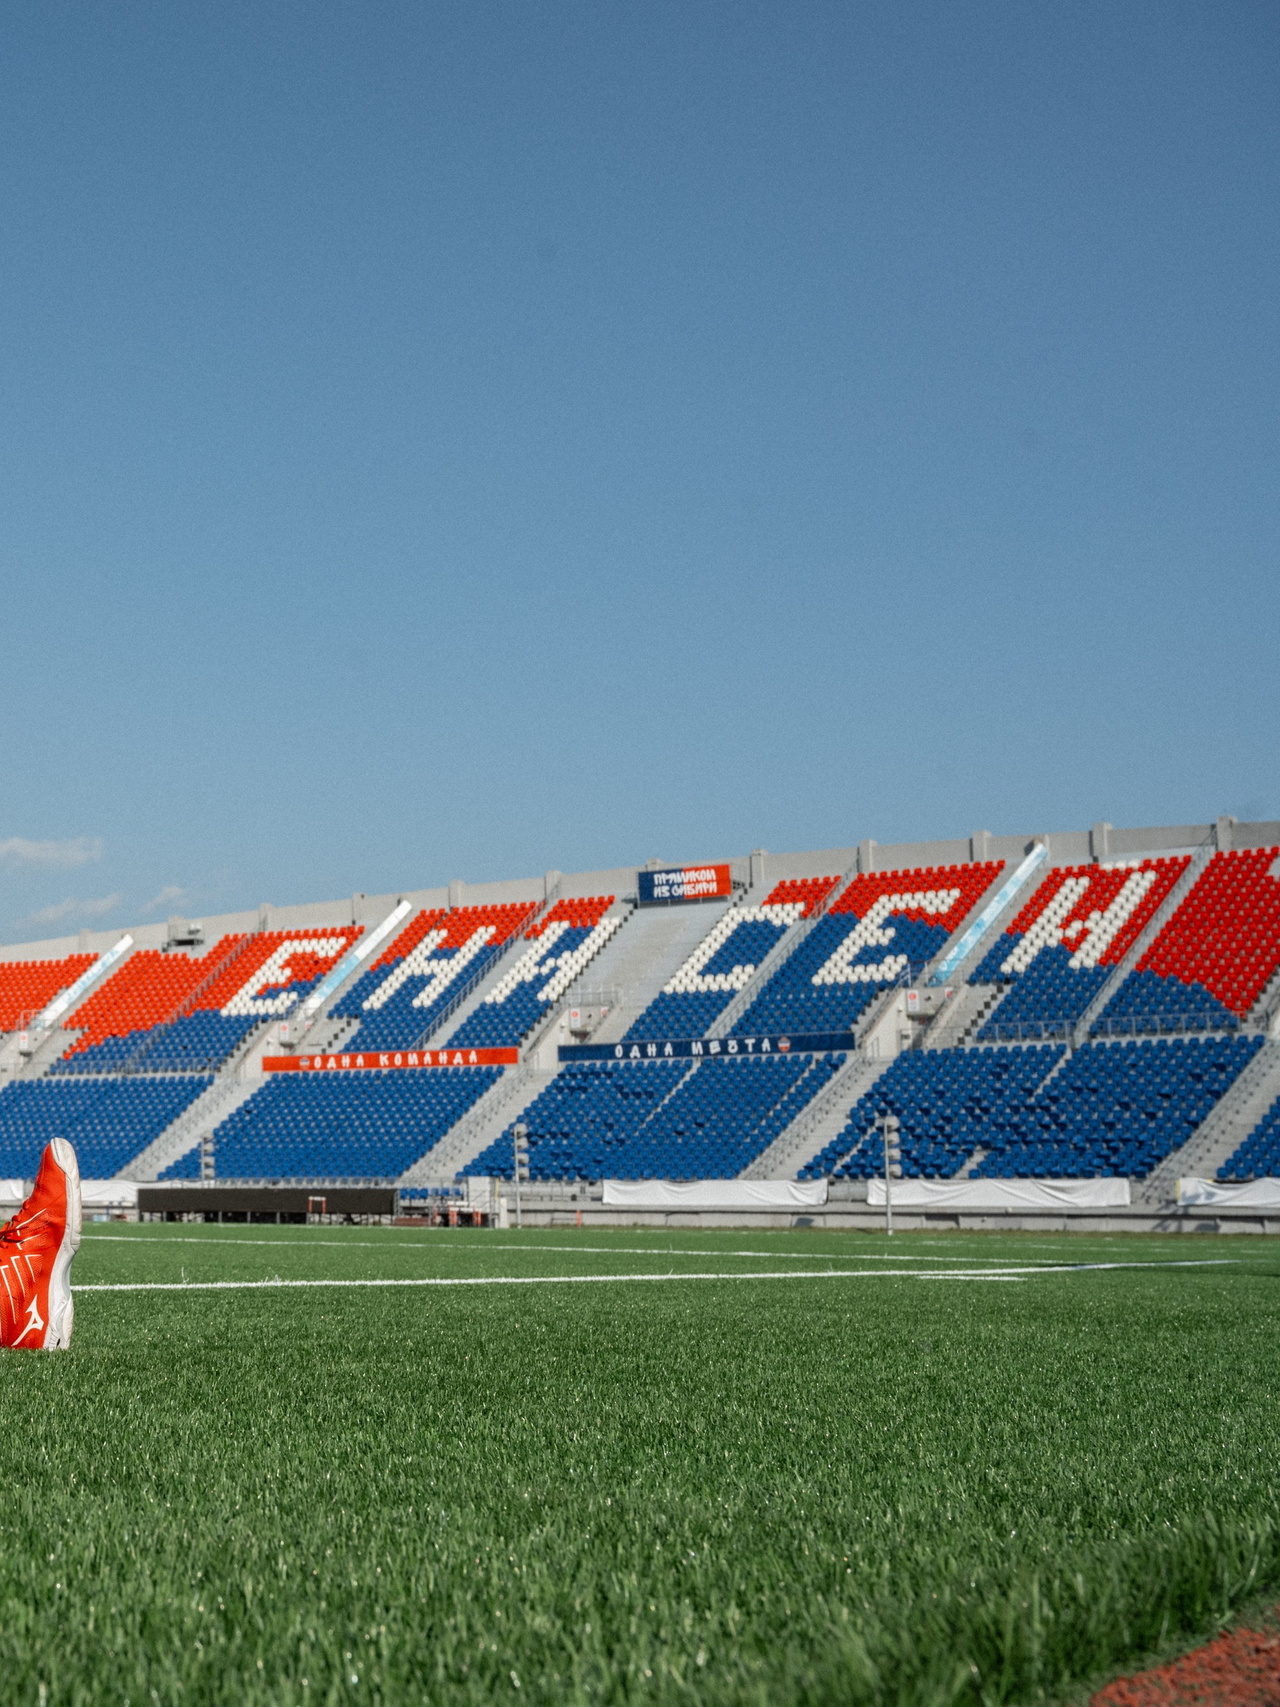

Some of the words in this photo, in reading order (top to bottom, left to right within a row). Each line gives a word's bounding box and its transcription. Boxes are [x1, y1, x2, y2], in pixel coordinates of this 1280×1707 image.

[653, 868, 717, 885] ПРЯМИКОМ
[653, 885, 670, 898] ИЗ
[671, 881, 717, 896] СИБИРИ
[615, 1042, 673, 1059] ОДНА
[314, 1054, 365, 1069] ОДНА
[379, 1050, 478, 1067] КОМАНДА
